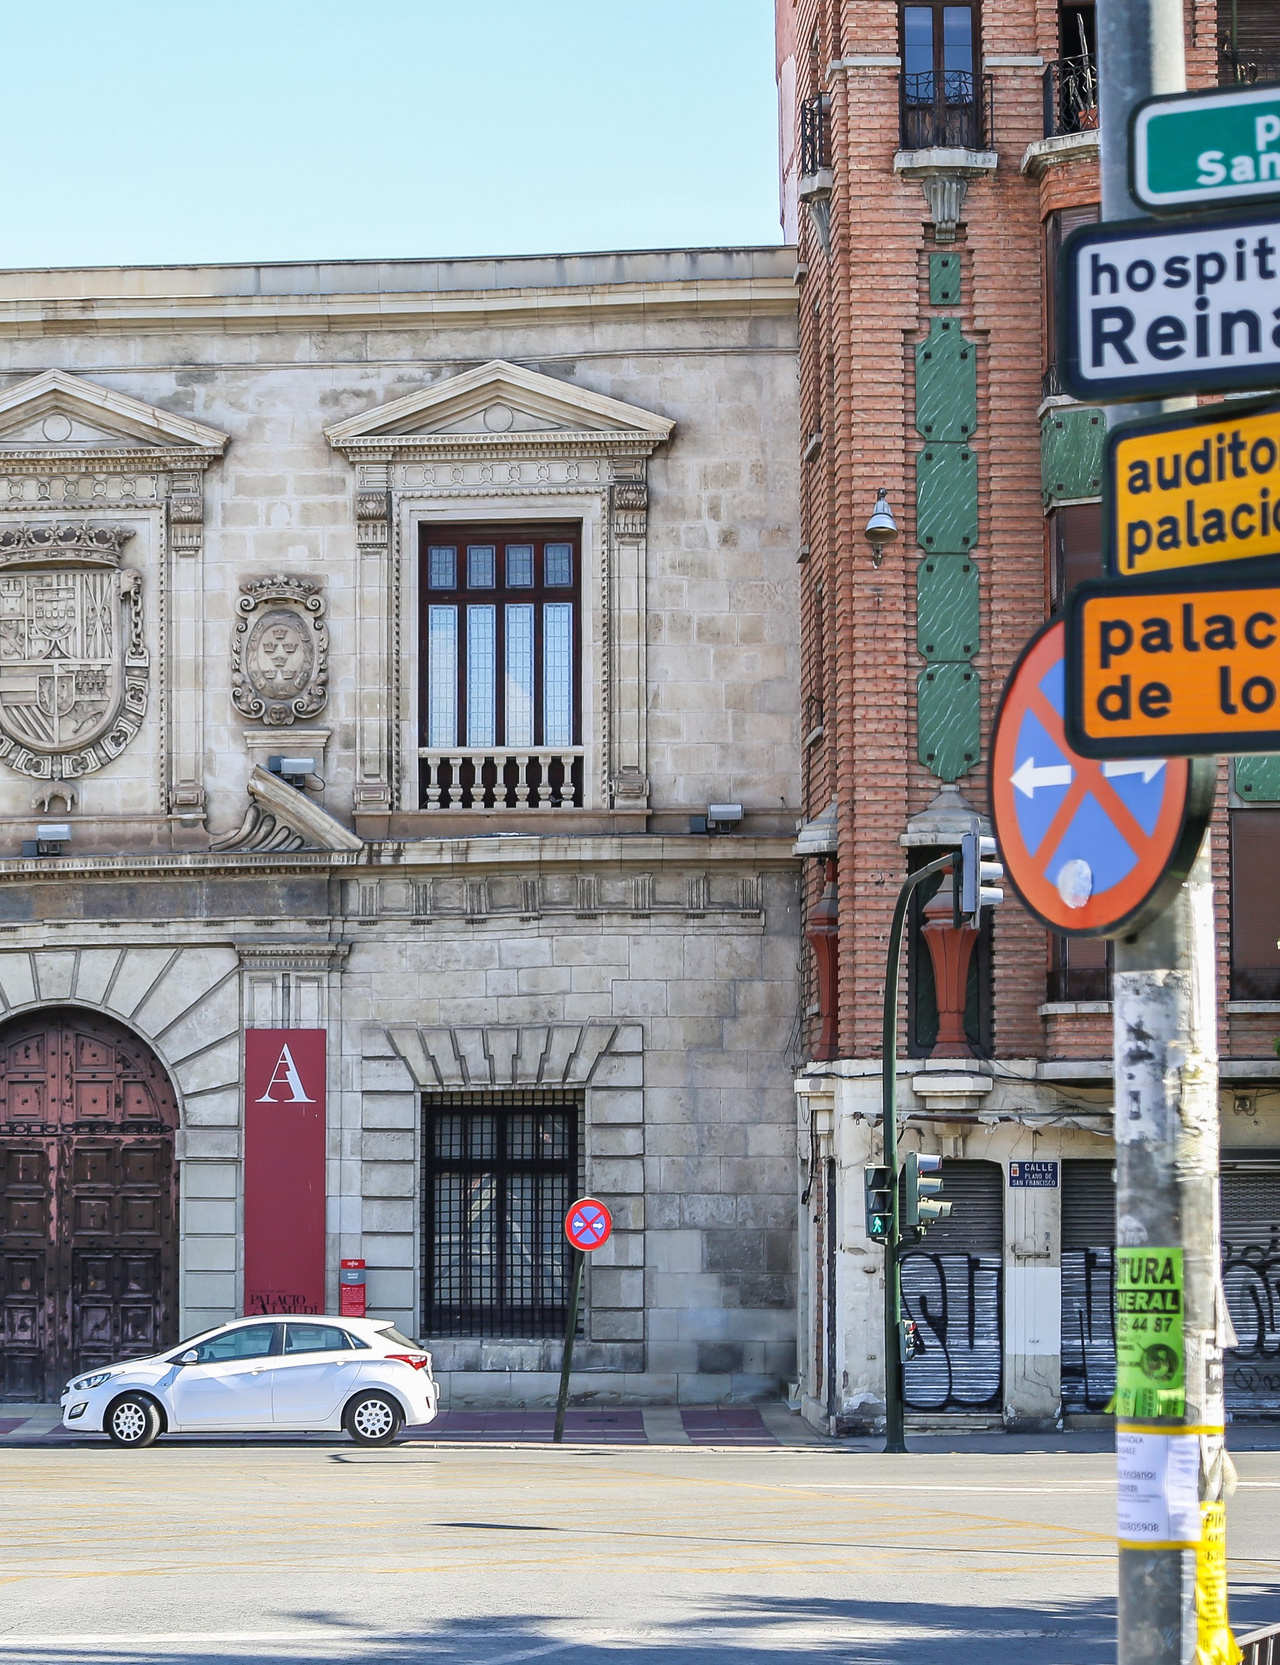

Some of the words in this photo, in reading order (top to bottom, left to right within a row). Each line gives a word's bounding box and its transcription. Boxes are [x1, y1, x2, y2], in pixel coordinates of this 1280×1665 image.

[1091, 296, 1280, 368] Rein
[1099, 603, 1278, 669] palac
[1097, 674, 1172, 721] de
[1220, 665, 1277, 714] lo
[255, 1043, 316, 1102] A
[1024, 1163, 1053, 1171] CALLE
[250, 1294, 306, 1305] PALACIO
[1132, 1317, 1148, 1332] 44
[1154, 1317, 1173, 1332] 87
